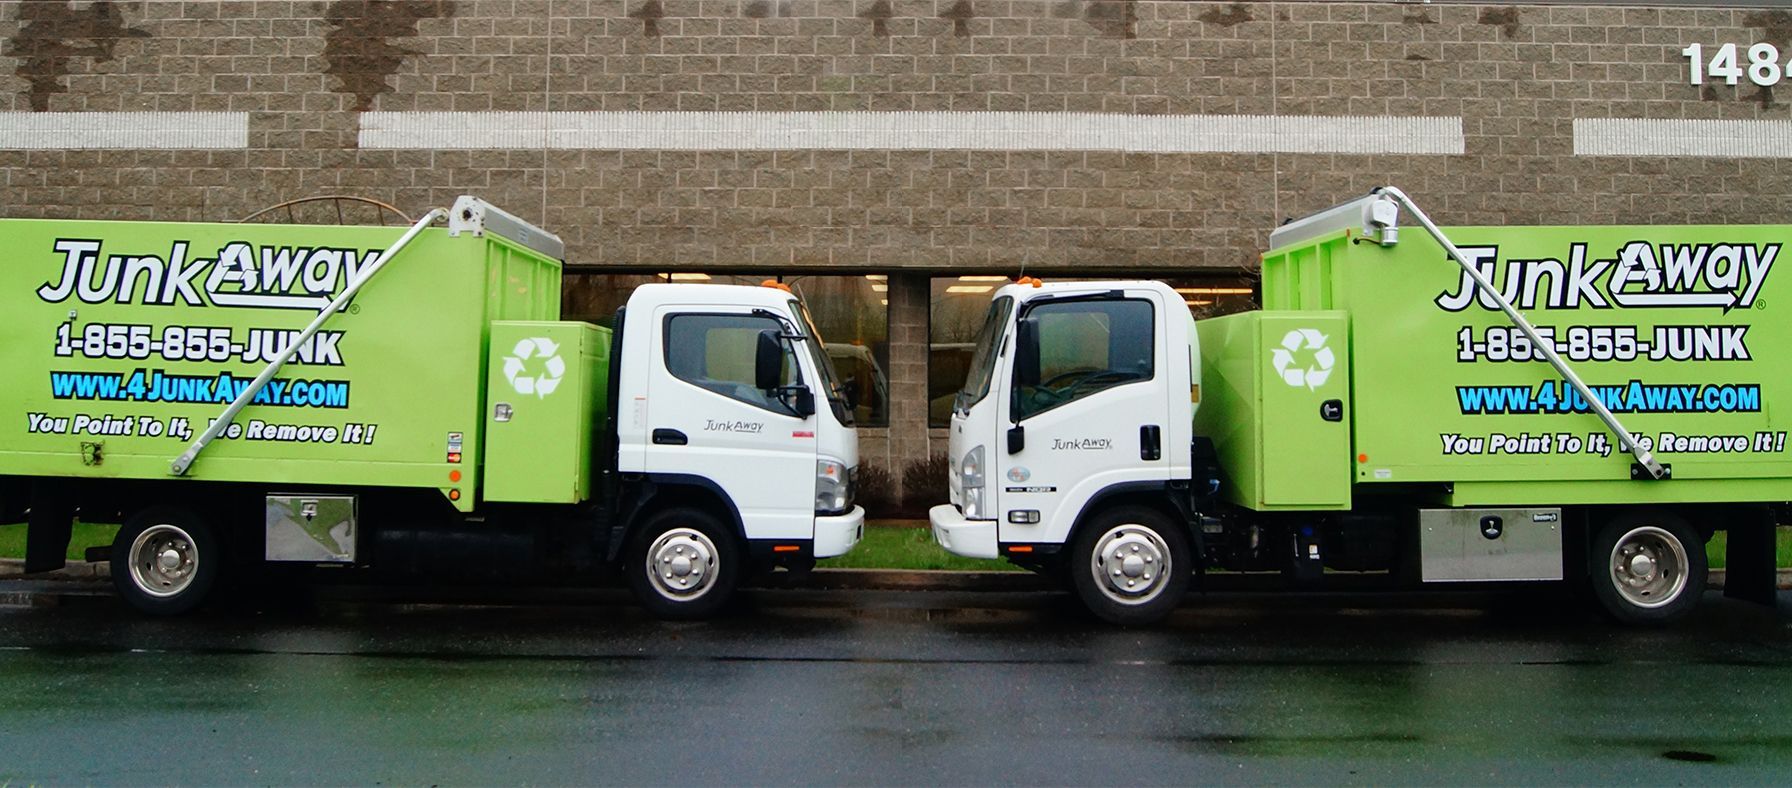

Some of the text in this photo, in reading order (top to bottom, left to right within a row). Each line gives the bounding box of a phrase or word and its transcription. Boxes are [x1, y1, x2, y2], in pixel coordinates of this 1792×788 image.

[1682, 42, 1792, 87] 148
[55, 323, 346, 366] 1-855-855-JUNK
[27, 413, 68, 434] You
[72, 415, 134, 436] Point
[138, 417, 164, 437] To
[167, 418, 193, 441] It,
[247, 419, 339, 443] Remove
[1441, 434, 1485, 455] You
[1488, 434, 1551, 454] Point
[1555, 434, 1583, 454] To
[1585, 433, 1612, 457] It,
[1658, 433, 1748, 454] Remove
